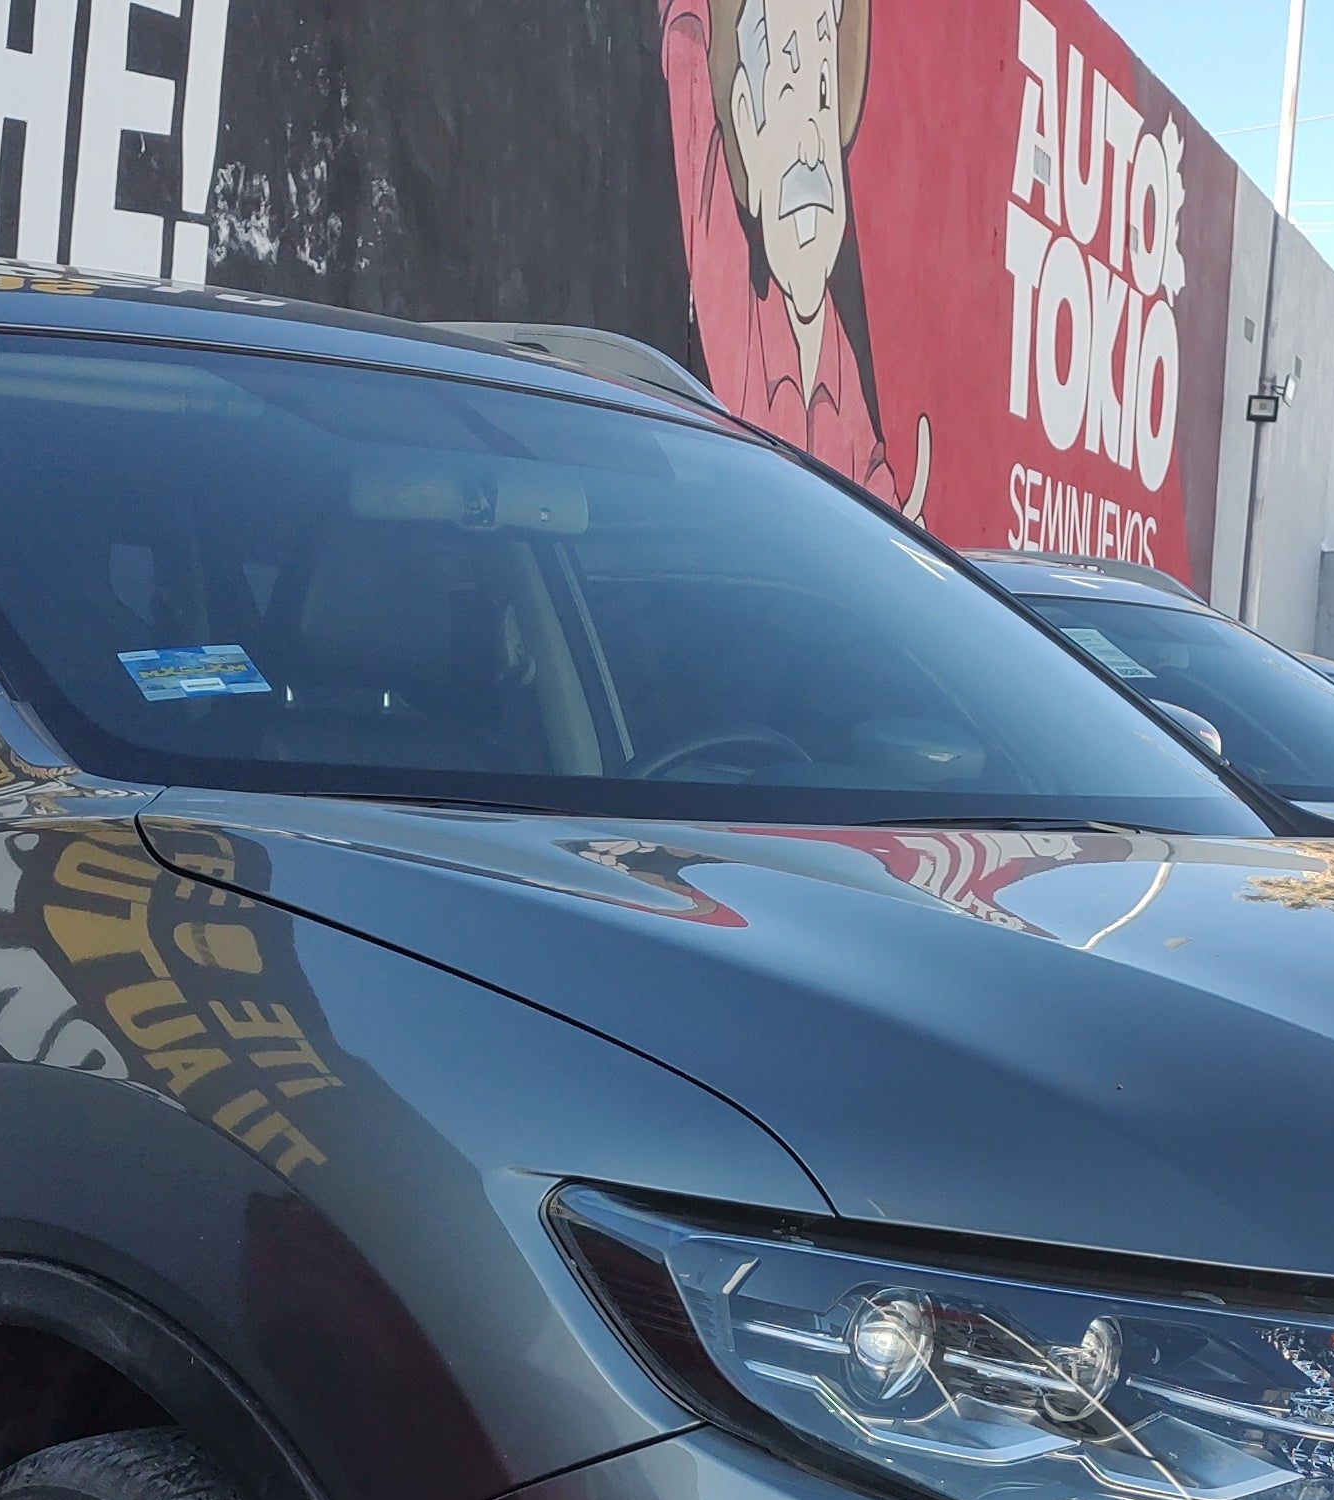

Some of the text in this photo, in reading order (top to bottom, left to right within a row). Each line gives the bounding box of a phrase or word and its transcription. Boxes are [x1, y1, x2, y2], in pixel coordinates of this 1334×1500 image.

[1012, 0, 1169, 297] AUTO
[1005, 200, 1179, 492] TOKIO
[1008, 462, 1159, 568] SEMINUEVOS
